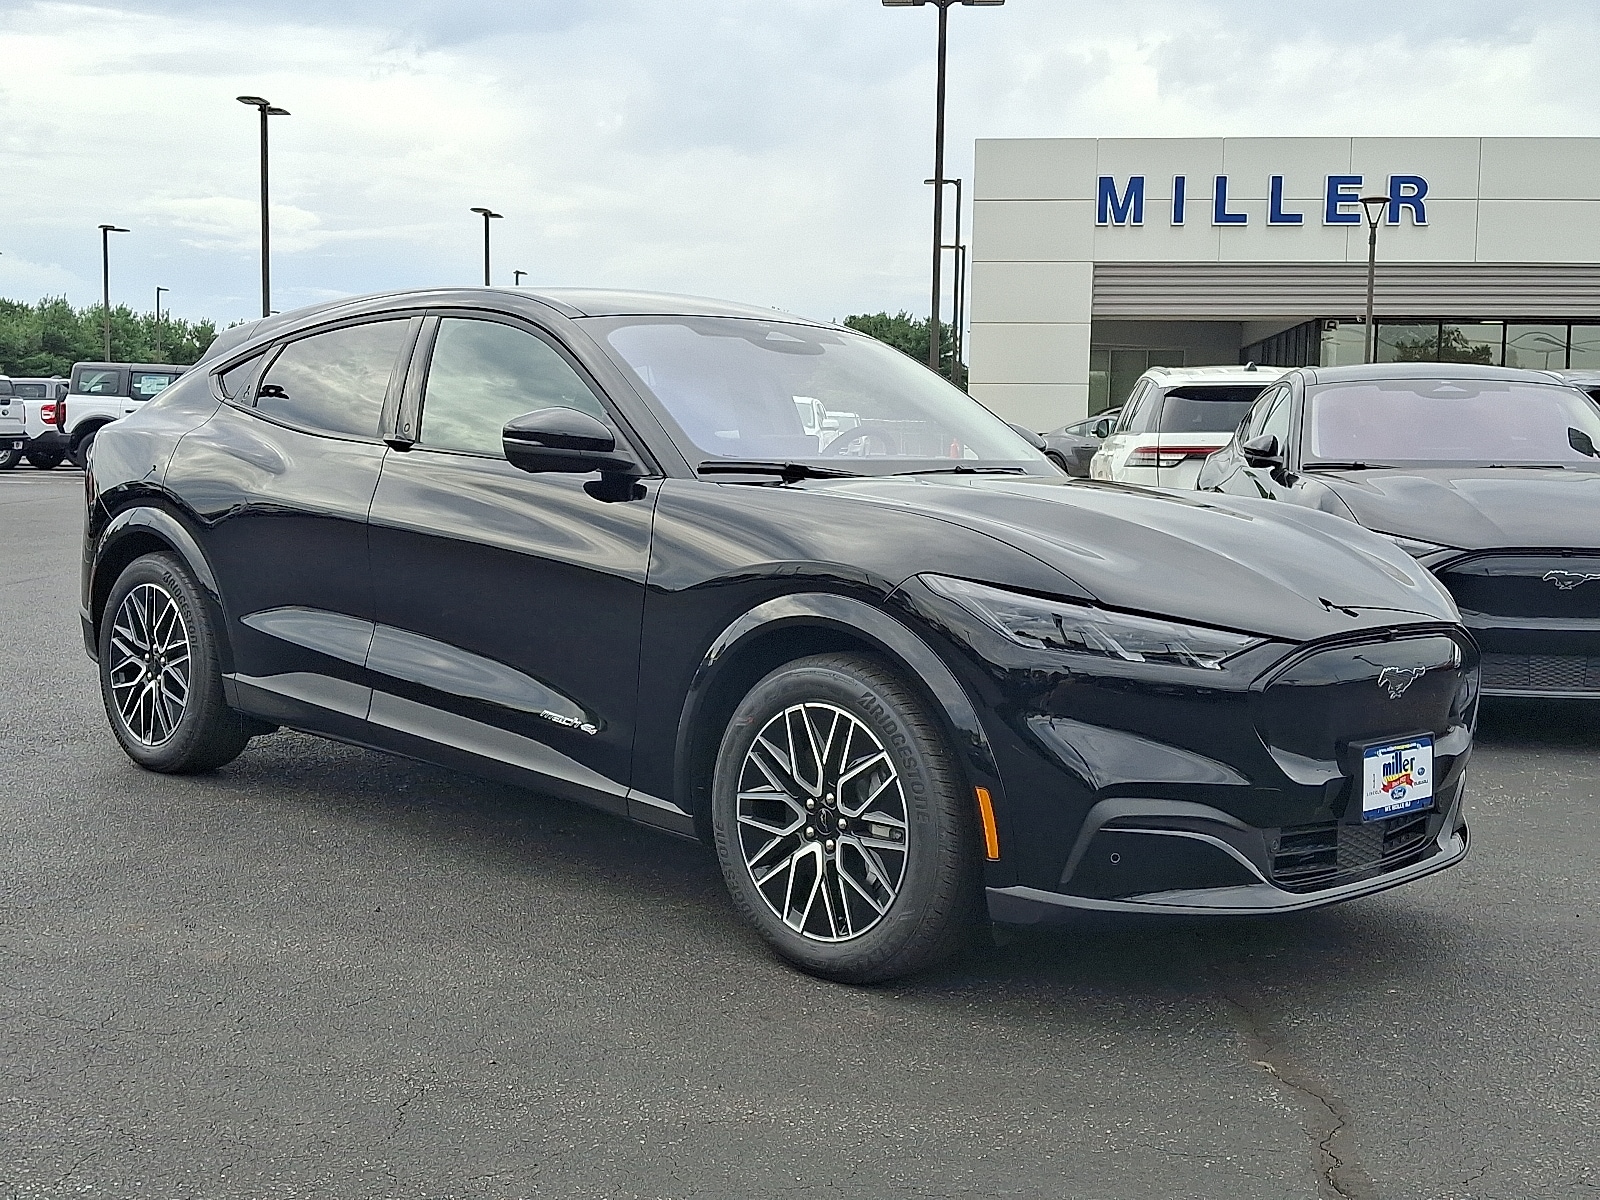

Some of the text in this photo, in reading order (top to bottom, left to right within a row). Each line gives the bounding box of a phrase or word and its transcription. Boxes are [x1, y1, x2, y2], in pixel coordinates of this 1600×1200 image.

[1095, 174, 1430, 226] MILLER
[162, 570, 199, 655] BRIDGESTONE
[857, 691, 930, 822] BRIDGESTONE
[1383, 750, 1416, 777] miller
